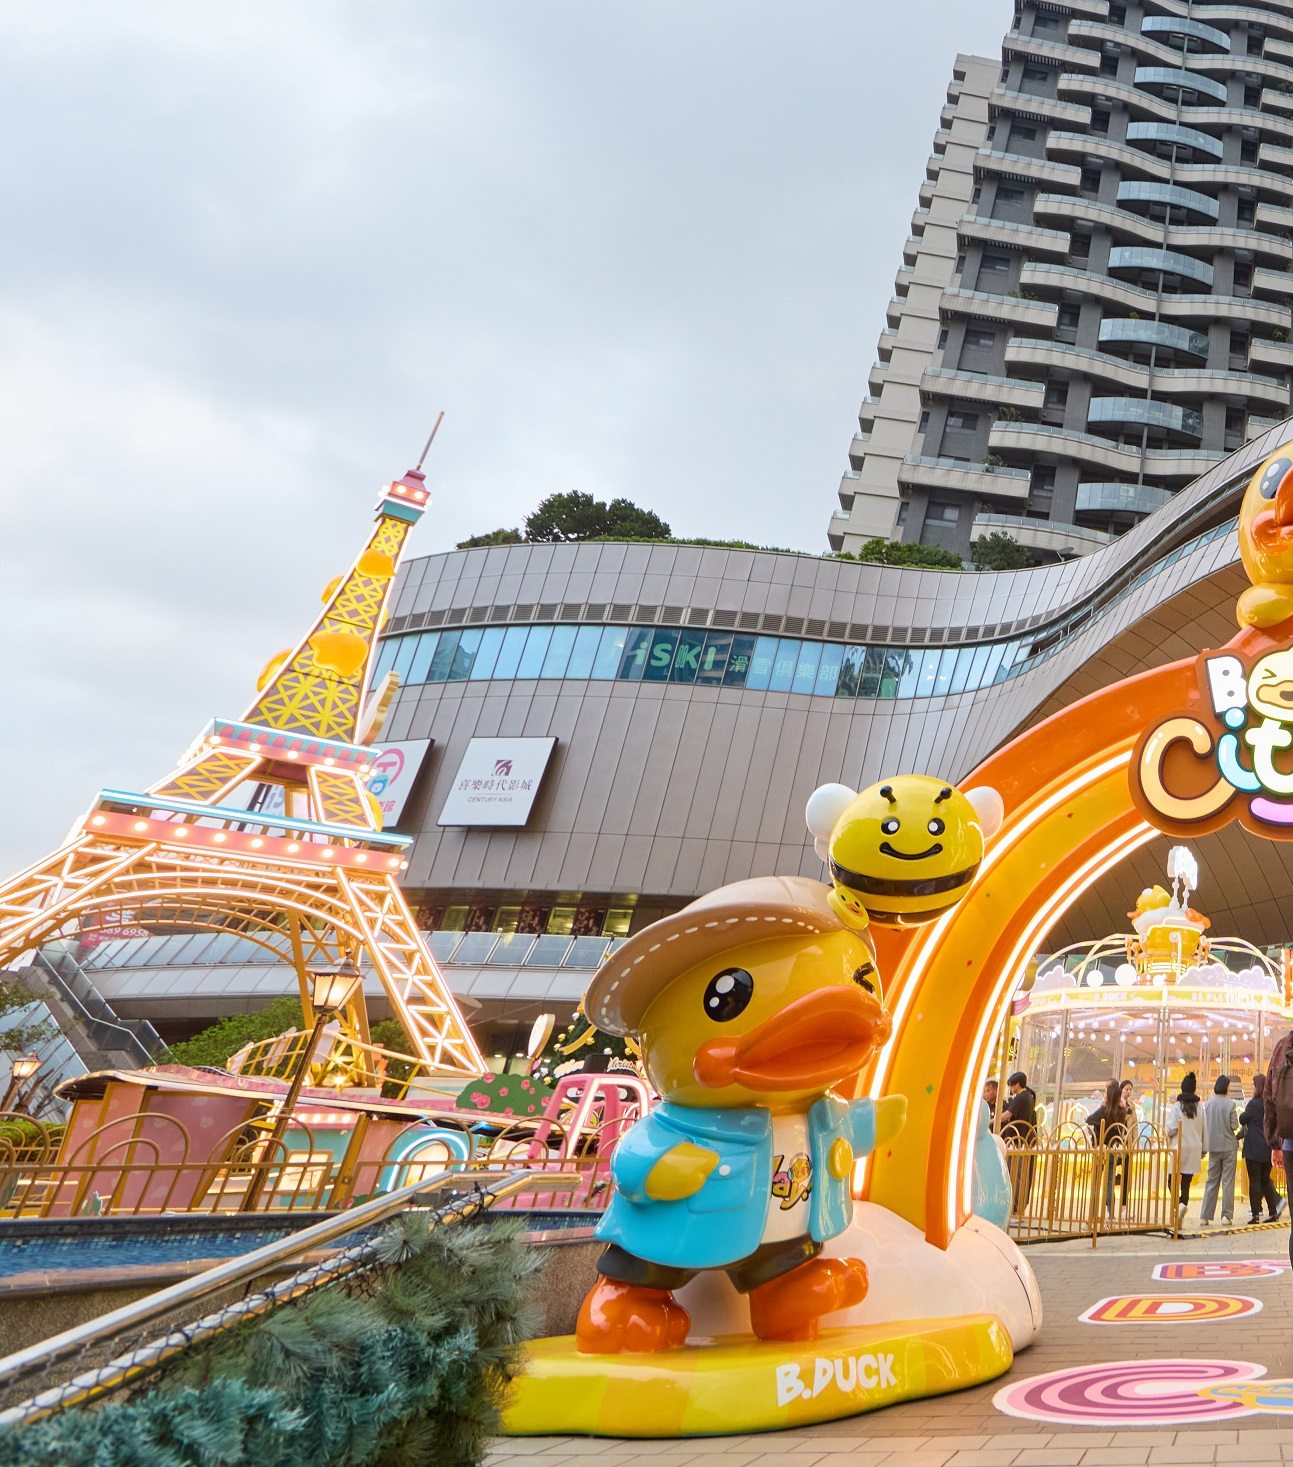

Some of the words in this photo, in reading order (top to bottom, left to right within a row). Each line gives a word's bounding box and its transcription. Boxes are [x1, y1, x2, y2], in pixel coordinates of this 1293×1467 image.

[729, 654, 840, 682] 滑雪俱樂部
[776, 1352, 898, 1408] B.DUCK
